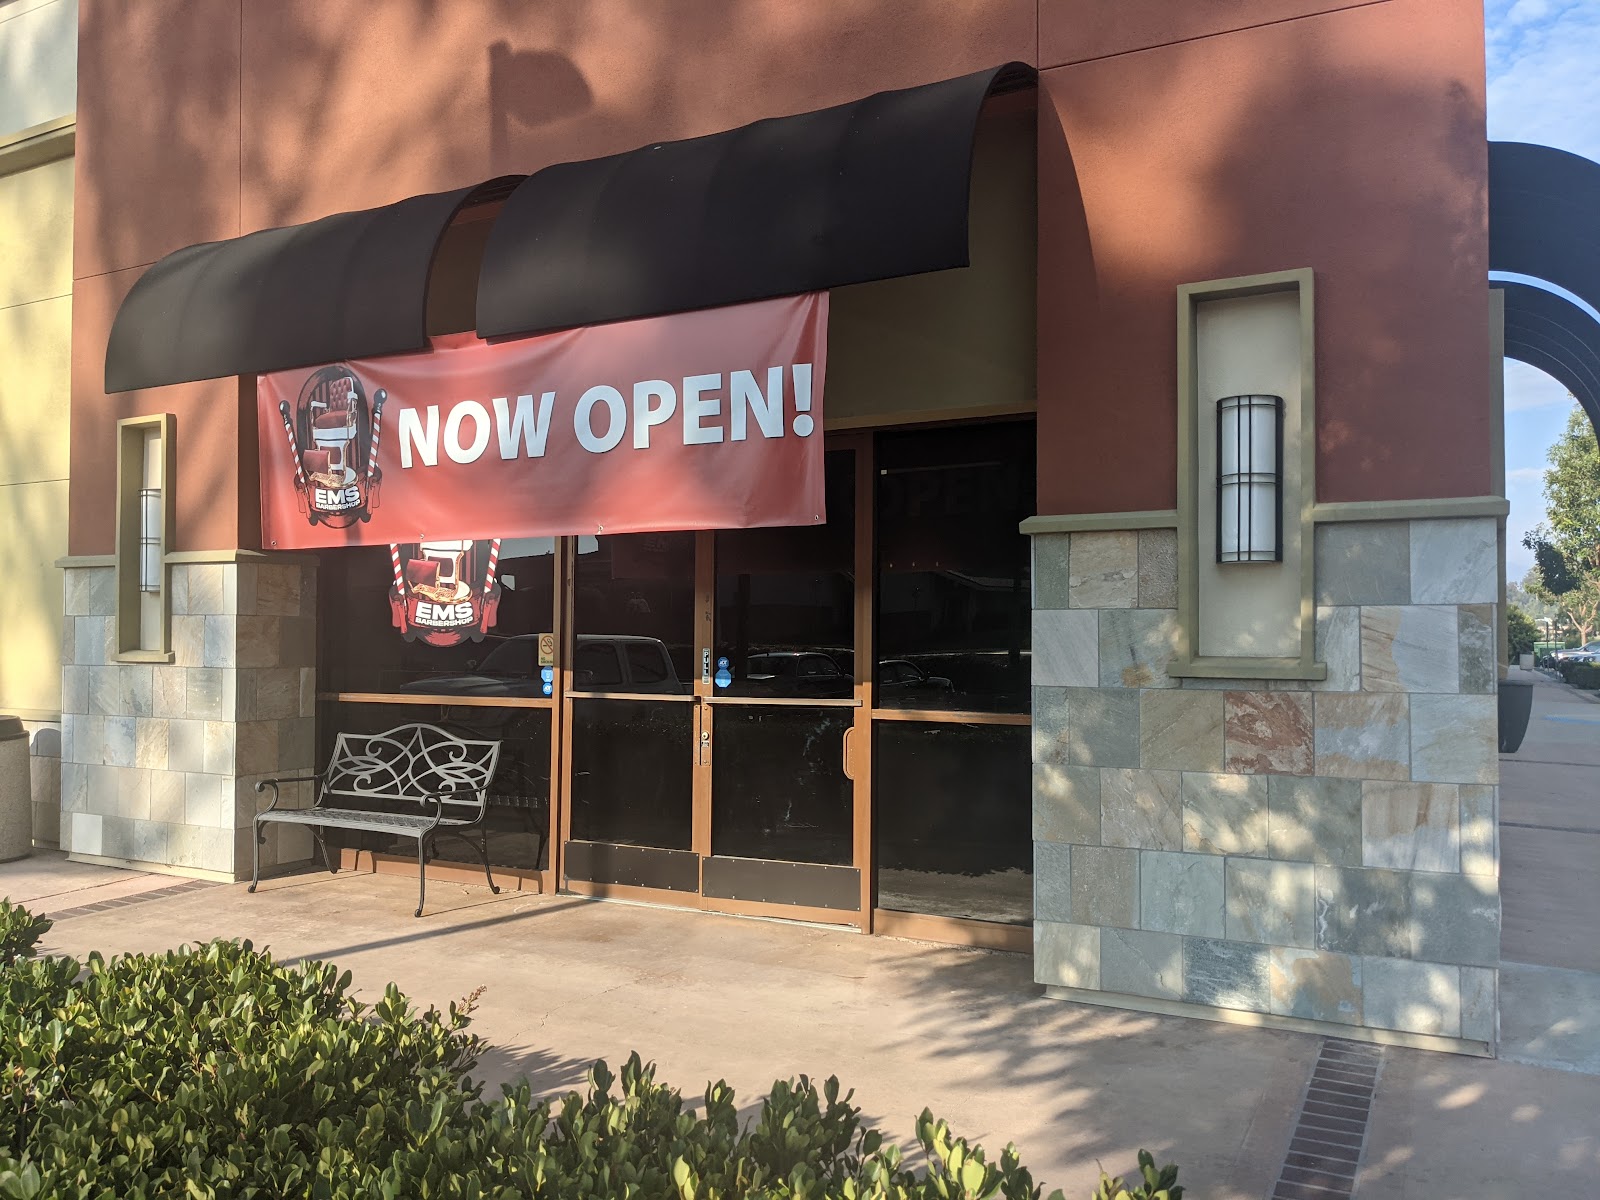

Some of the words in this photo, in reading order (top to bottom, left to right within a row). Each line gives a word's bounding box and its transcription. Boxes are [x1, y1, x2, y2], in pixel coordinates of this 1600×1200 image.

[398, 392, 556, 469] NOW
[573, 363, 814, 454] OPEN!
[315, 486, 360, 504] EMS
[315, 499, 360, 510] BARBERSHOP
[416, 601, 474, 621] EMS
[415, 616, 474, 627] BARBERSHOP
